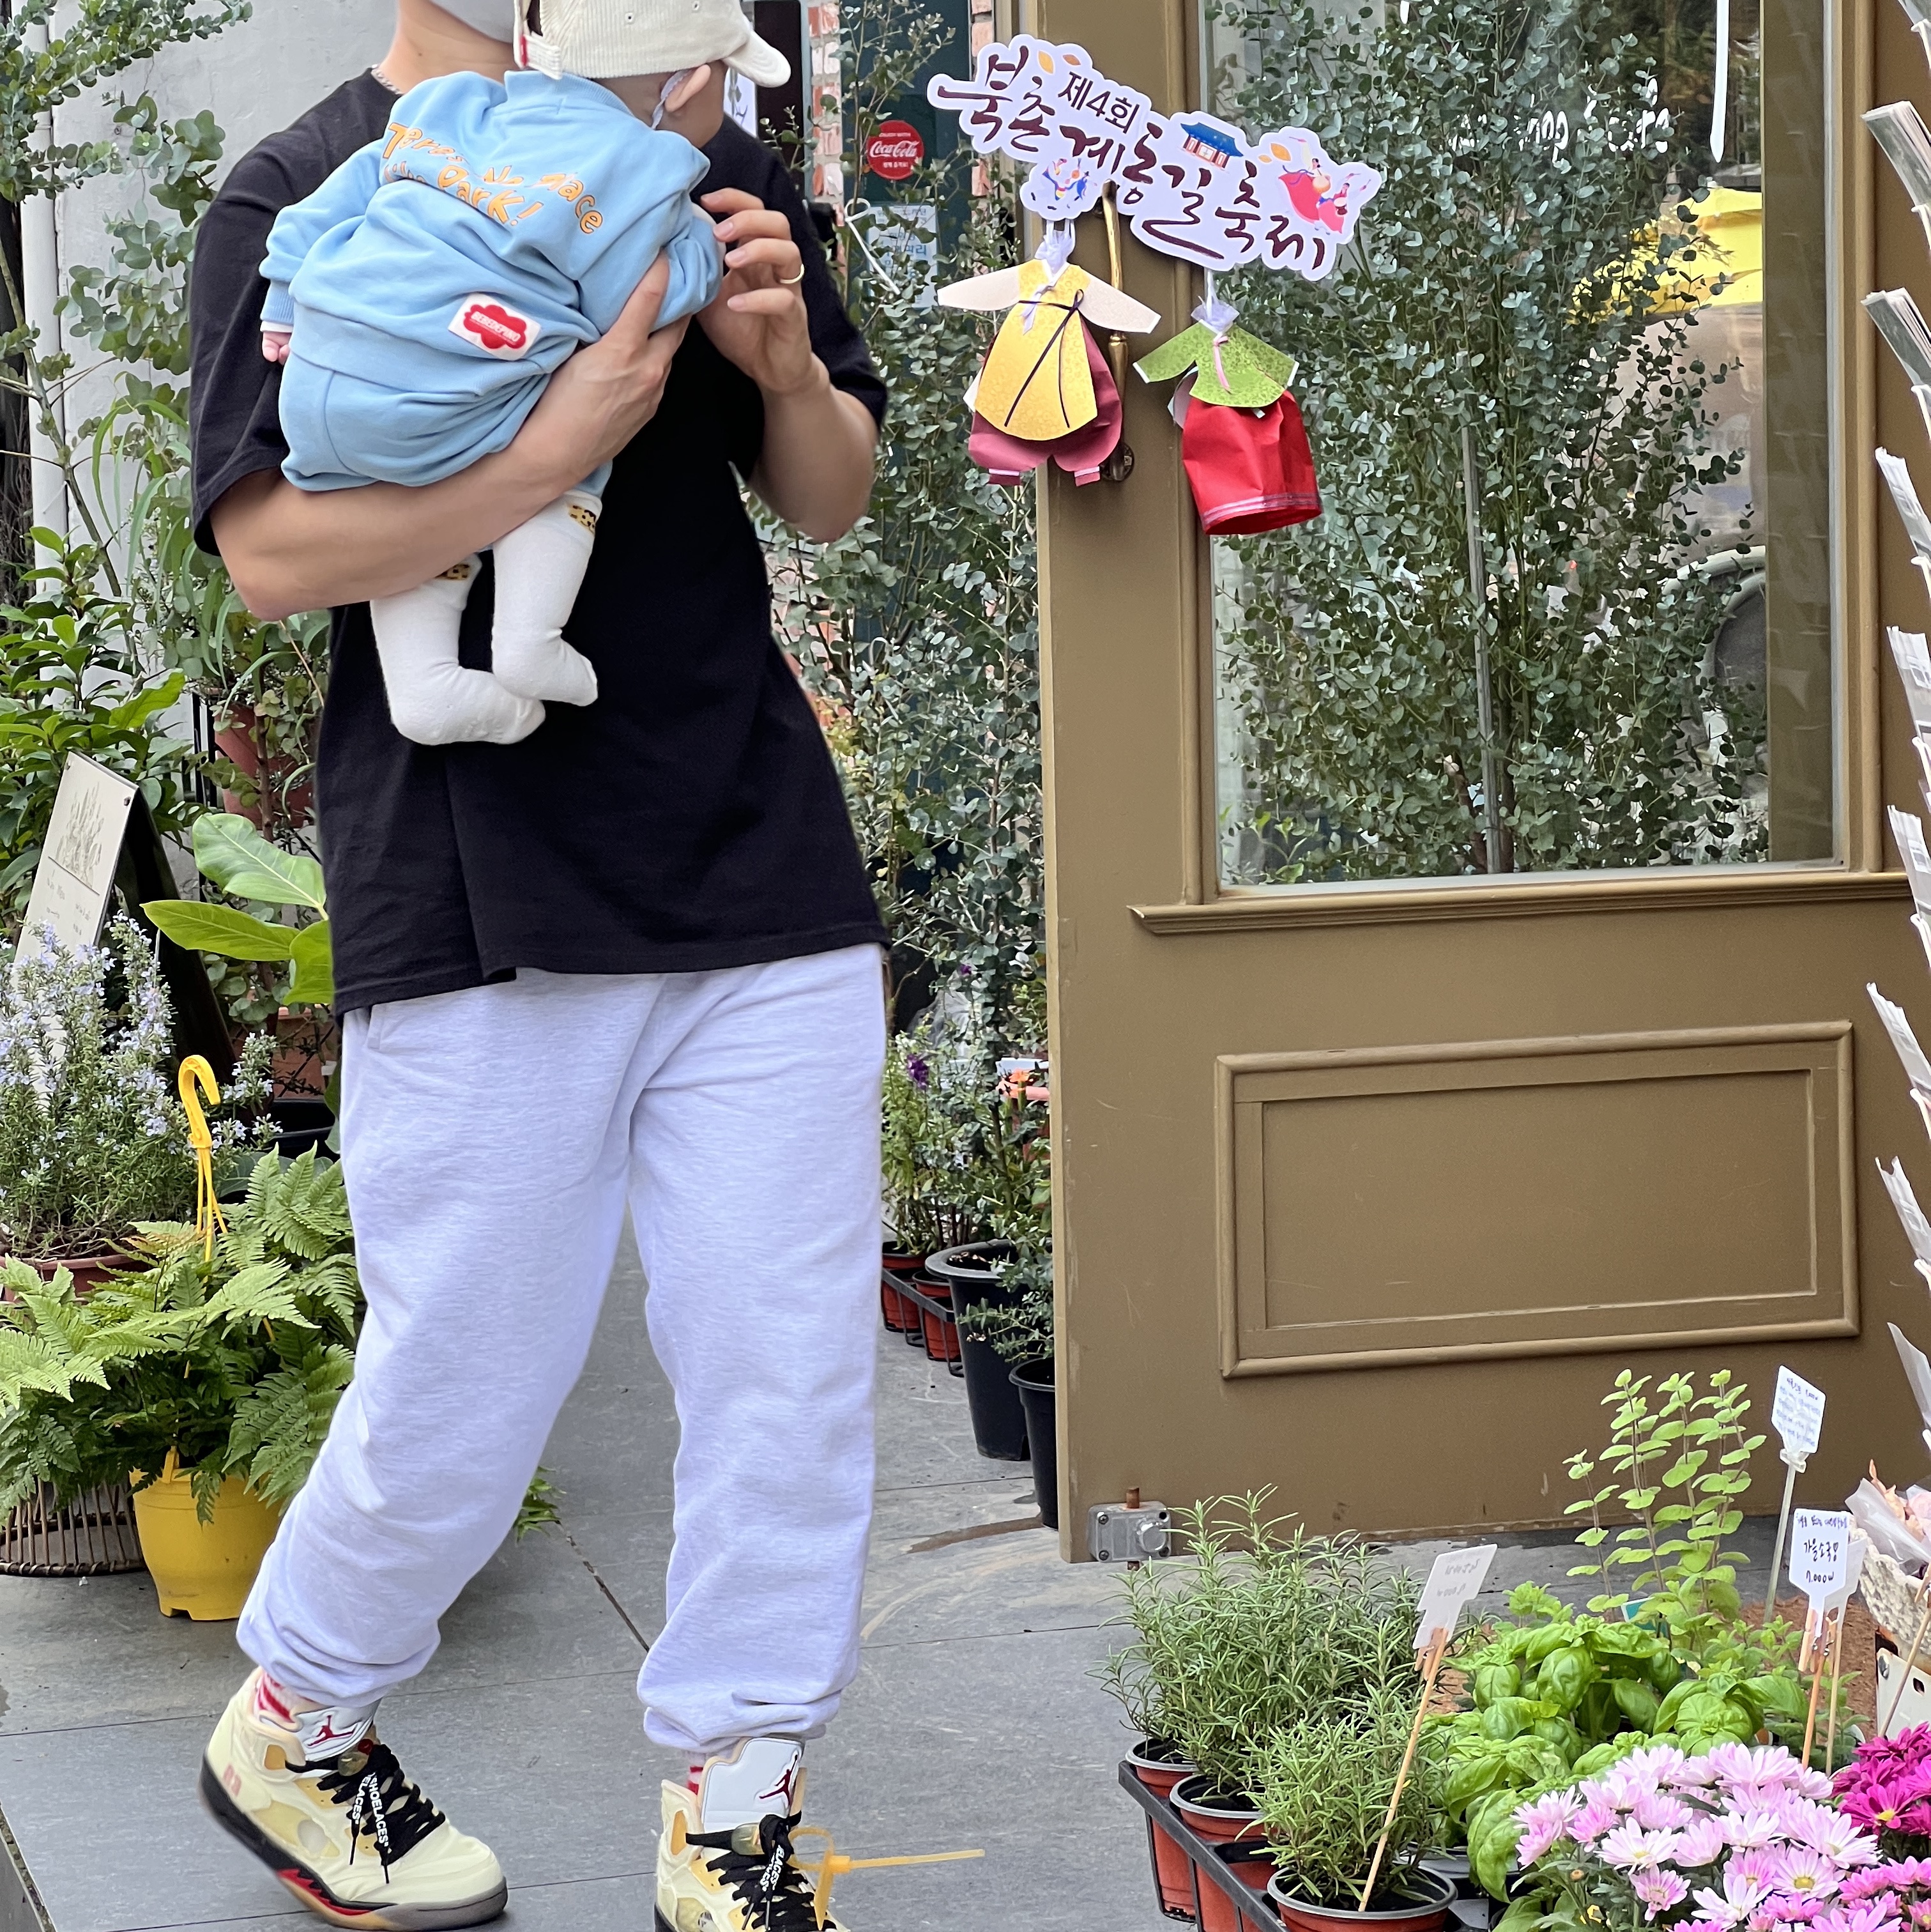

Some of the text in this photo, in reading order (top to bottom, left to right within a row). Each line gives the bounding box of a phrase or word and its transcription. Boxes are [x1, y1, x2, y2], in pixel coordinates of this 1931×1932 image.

[938, 45, 1325, 270] 북촌 계동길 축제
[1058, 71, 1140, 134] 제4회
